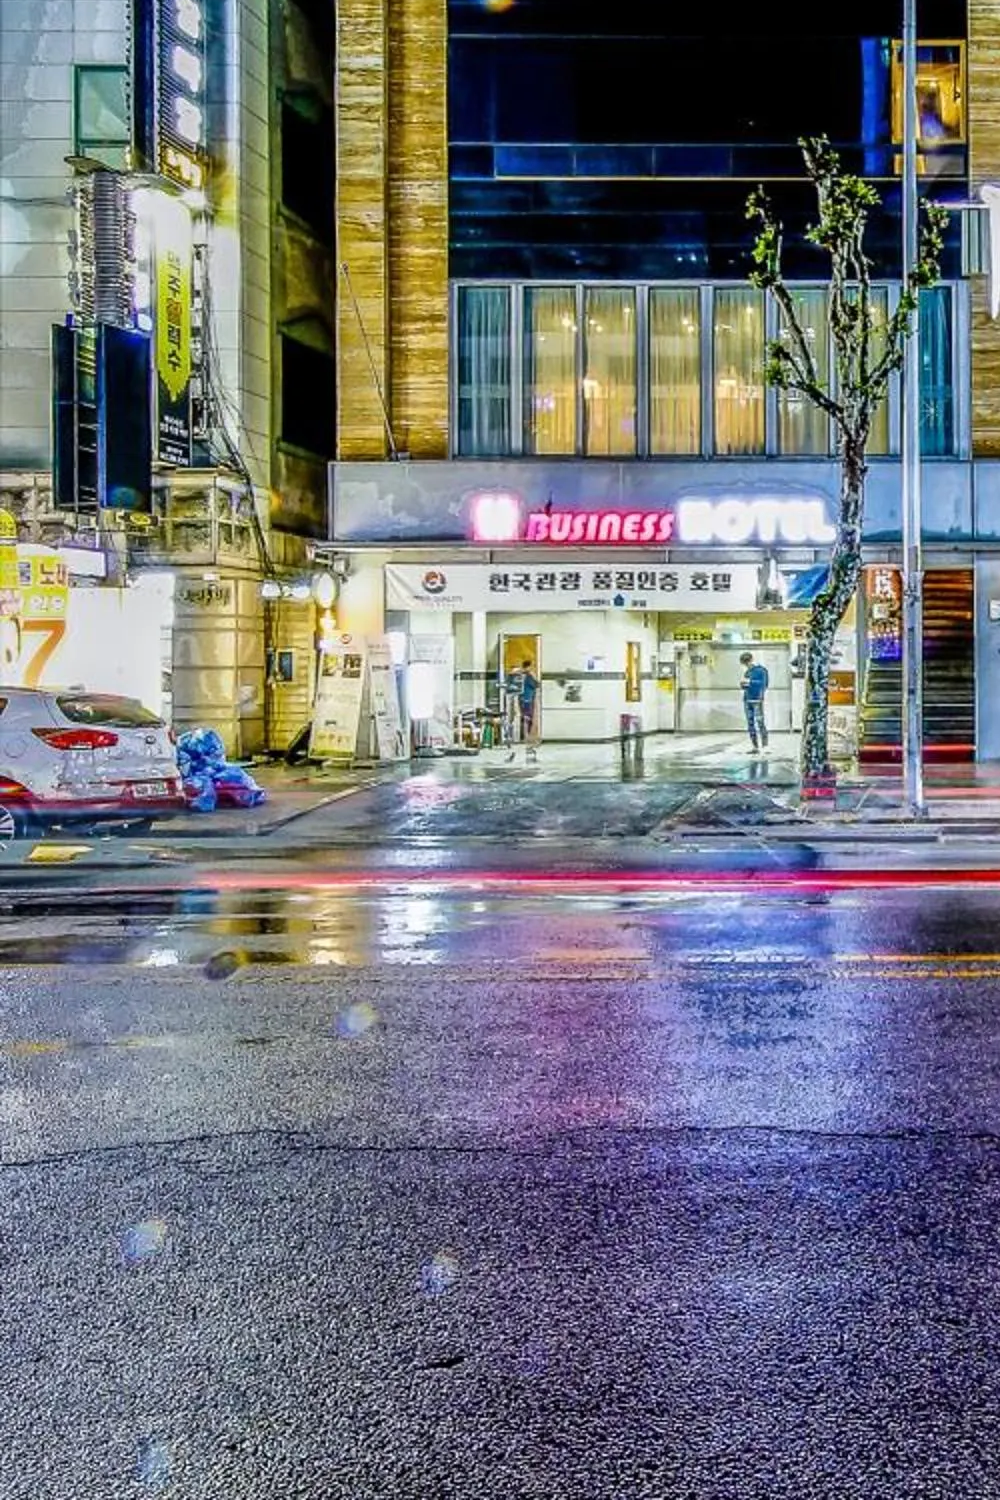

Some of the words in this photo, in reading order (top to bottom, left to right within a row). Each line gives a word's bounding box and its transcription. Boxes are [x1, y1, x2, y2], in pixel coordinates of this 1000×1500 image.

[527, 512, 675, 542] BUSINESS
[679, 500, 837, 542] HOTEL
[488, 571, 582, 593] 한국관광
[591, 570, 679, 593] 품질인증
[689, 571, 732, 593] 호텔
